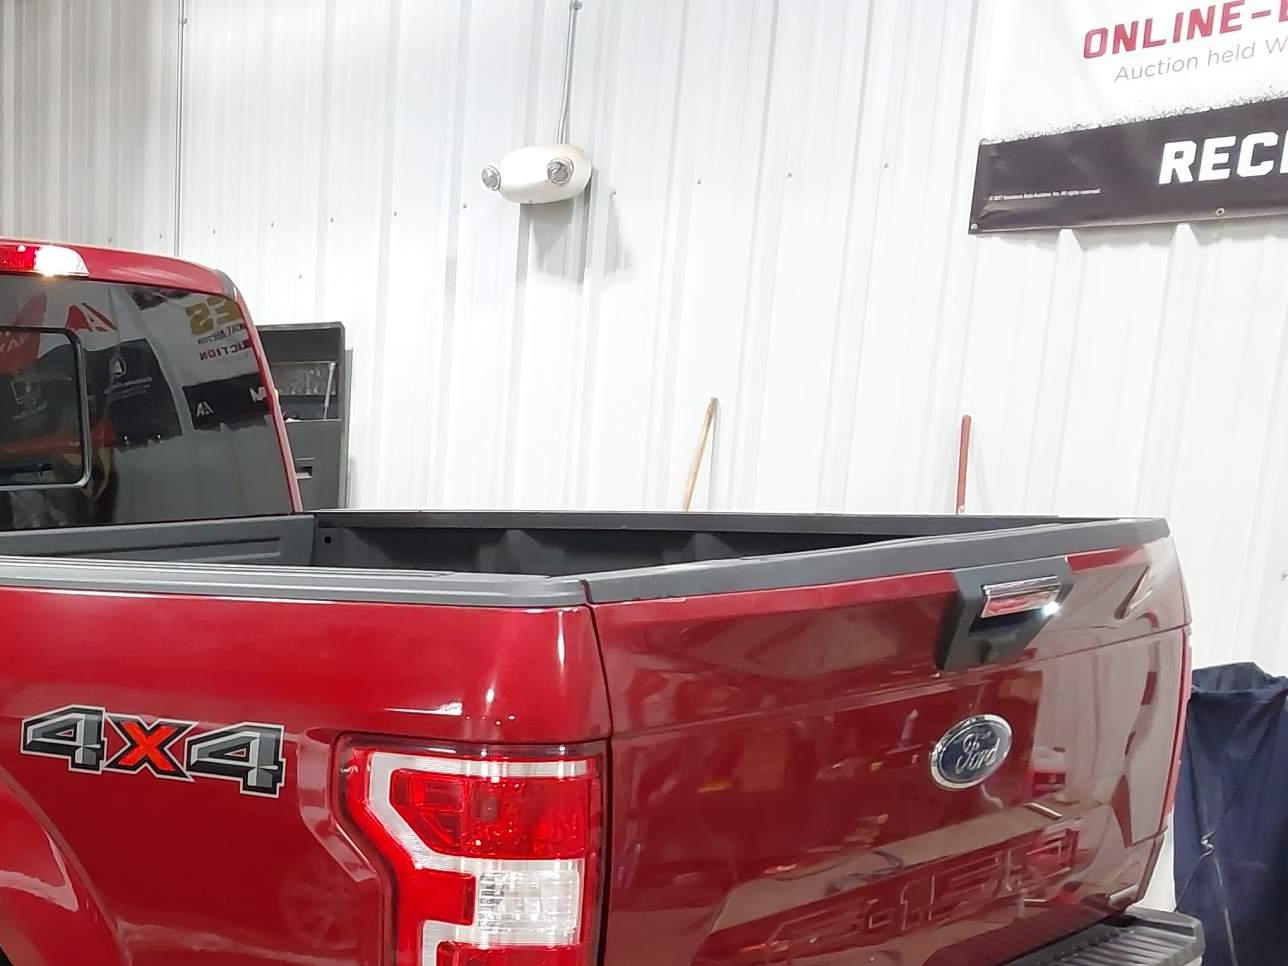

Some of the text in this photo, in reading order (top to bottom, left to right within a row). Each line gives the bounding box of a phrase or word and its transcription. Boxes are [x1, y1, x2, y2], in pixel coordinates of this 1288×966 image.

[1113, 55, 1199, 82] Auction
[1207, 41, 1256, 66] held
[954, 731, 1001, 775] Ford
